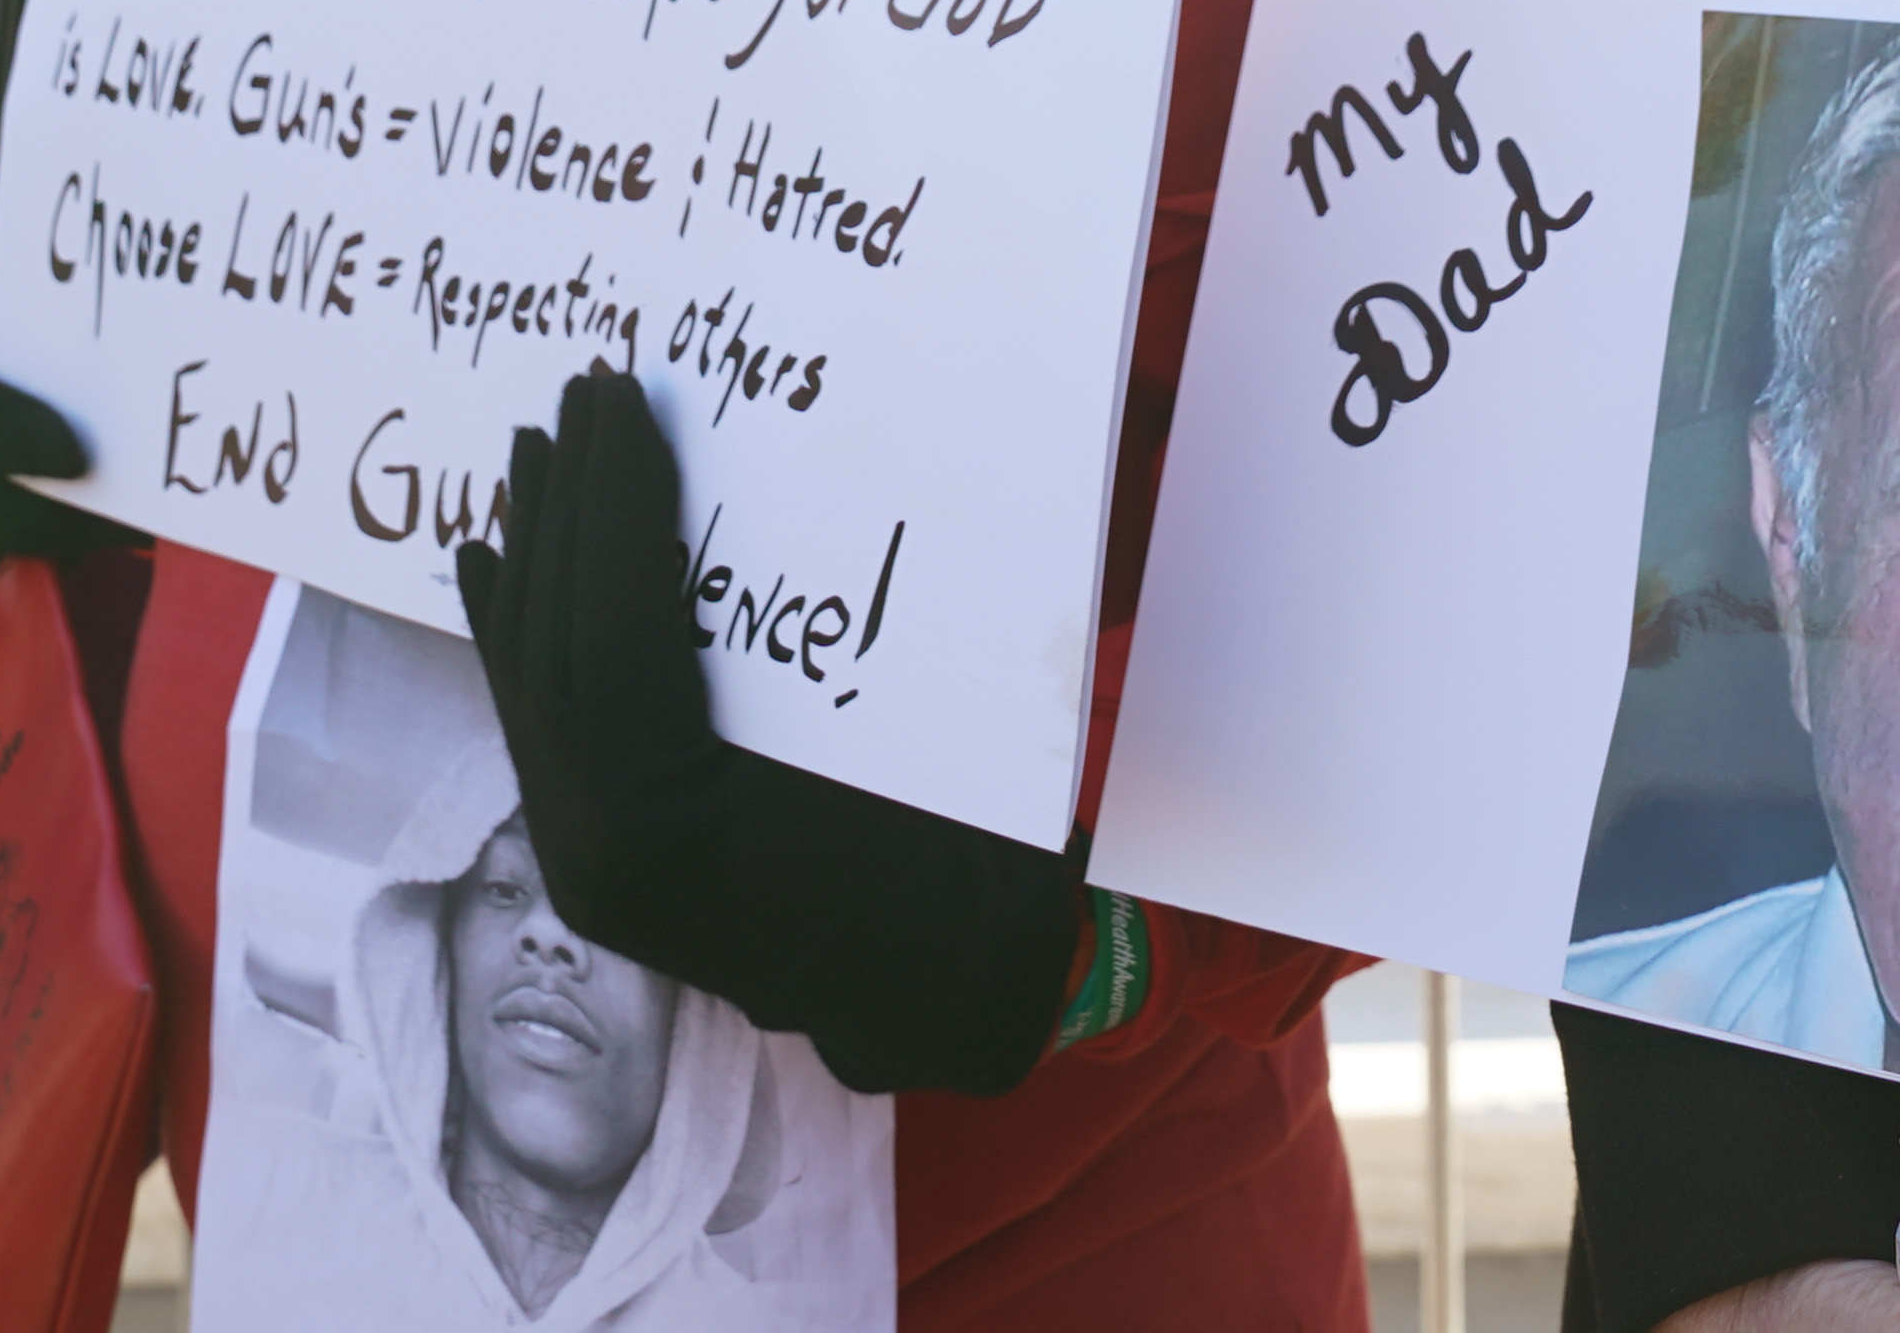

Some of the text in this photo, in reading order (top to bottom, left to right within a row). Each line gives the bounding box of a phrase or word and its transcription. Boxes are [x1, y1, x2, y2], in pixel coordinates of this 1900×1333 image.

[48, 159, 204, 341] Choose
[220, 190, 366, 321] LOVE
[411, 234, 643, 379] Respecting
[1330, 136, 1595, 449] Dad
